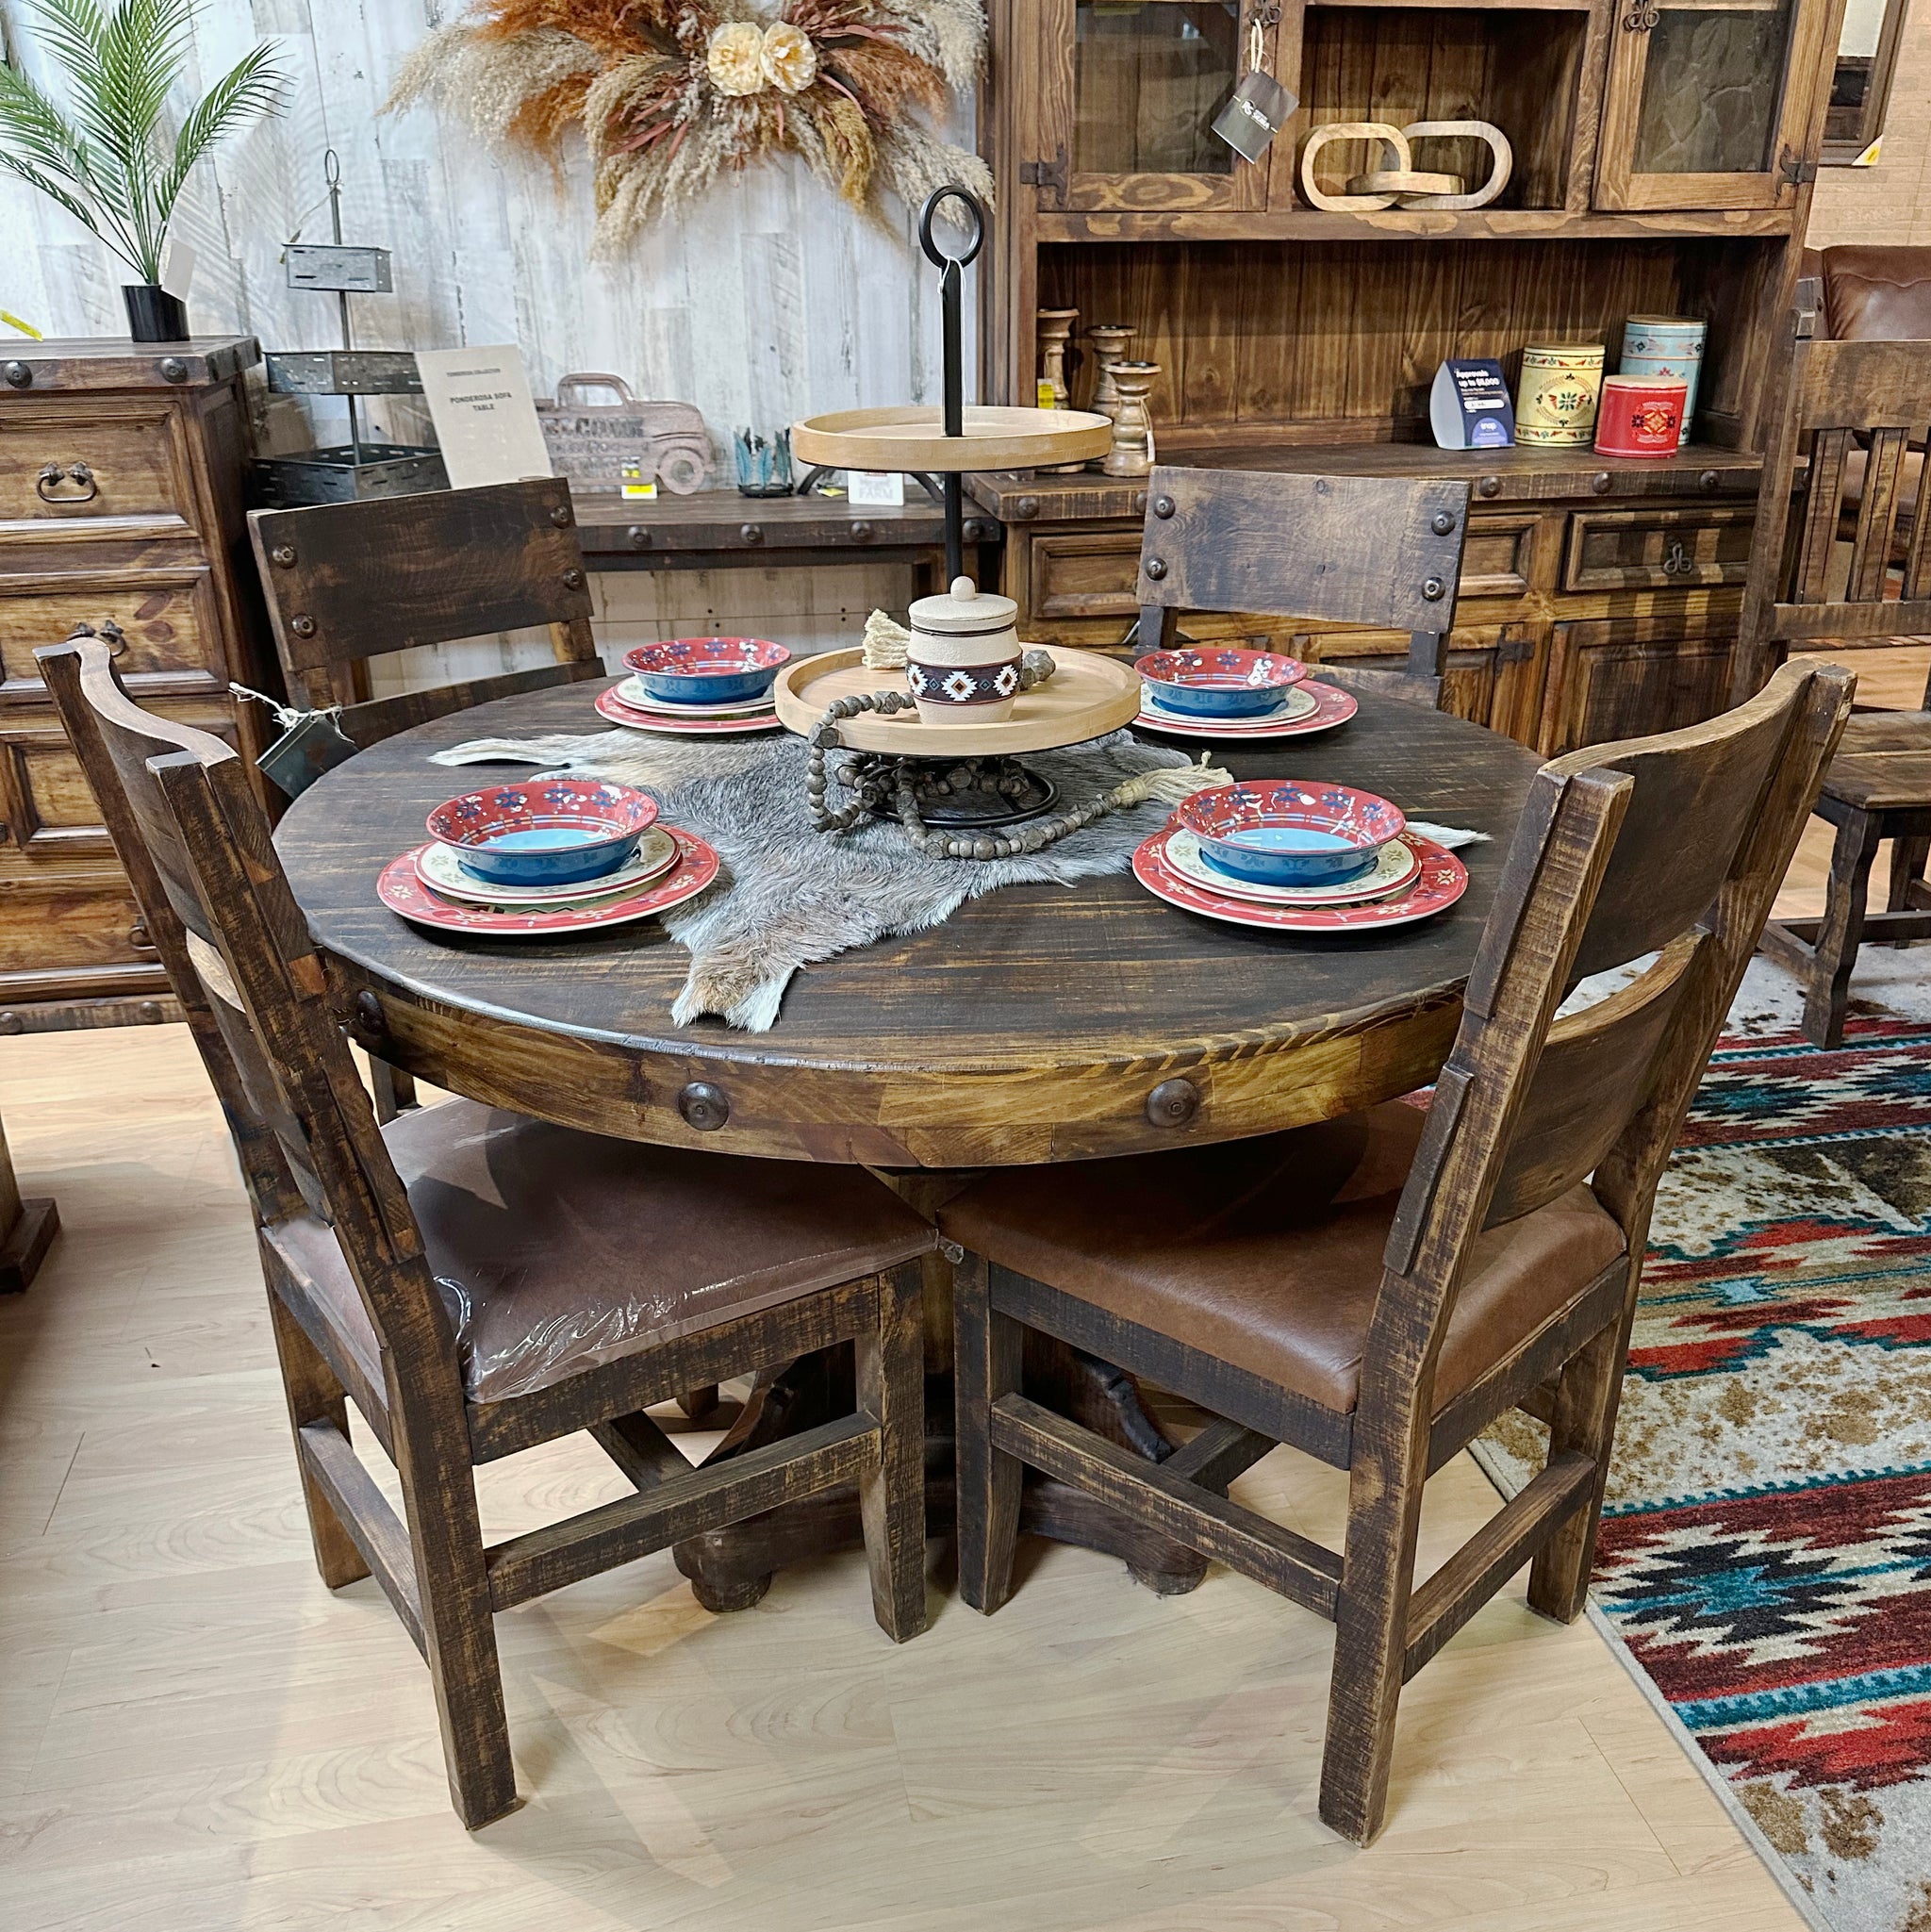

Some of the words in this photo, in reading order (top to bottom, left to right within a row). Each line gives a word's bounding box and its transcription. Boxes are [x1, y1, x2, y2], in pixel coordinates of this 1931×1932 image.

[1456, 370, 1489, 379] Approvals
[450, 394, 493, 404] PONDEROSA
[493, 391, 512, 400] SOFA
